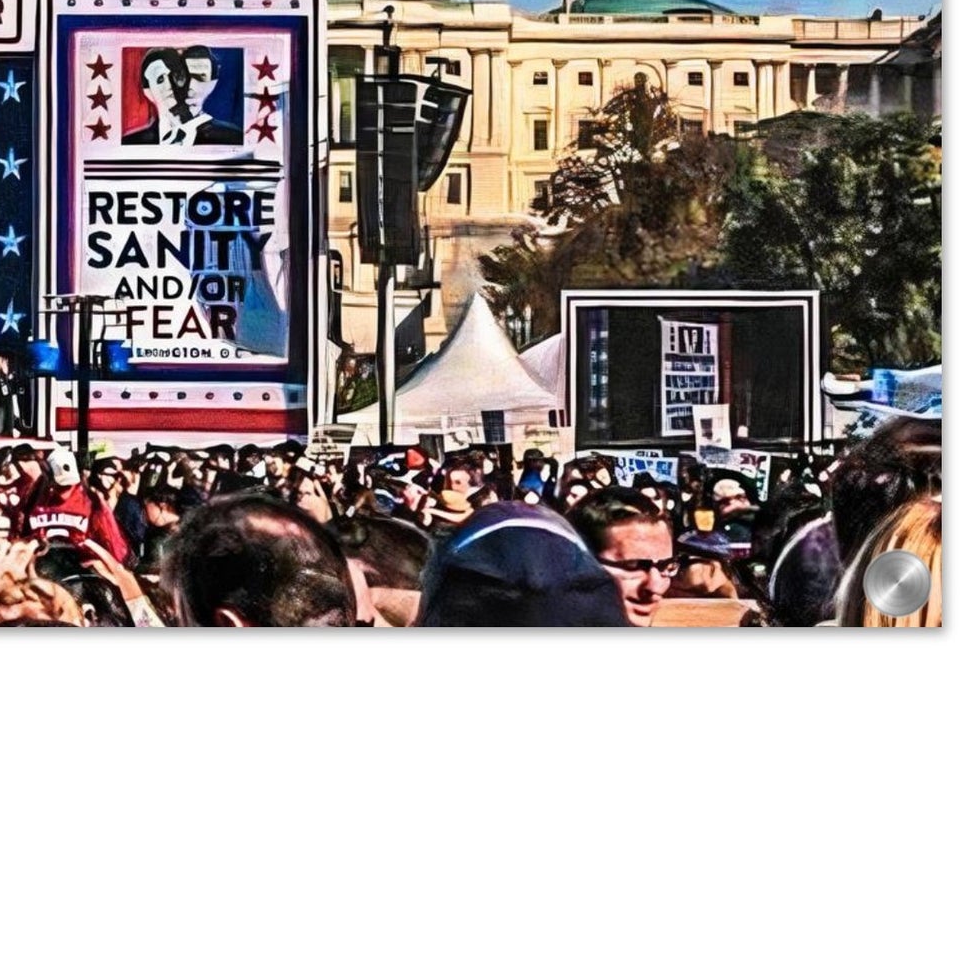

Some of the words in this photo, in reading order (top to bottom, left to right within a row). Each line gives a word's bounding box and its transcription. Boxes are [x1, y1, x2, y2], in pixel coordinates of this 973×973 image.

[88, 191, 275, 226] RESTORE
[87, 230, 273, 271] SANITY
[115, 275, 245, 303] AND/OR
[126, 305, 238, 340] FEAR
